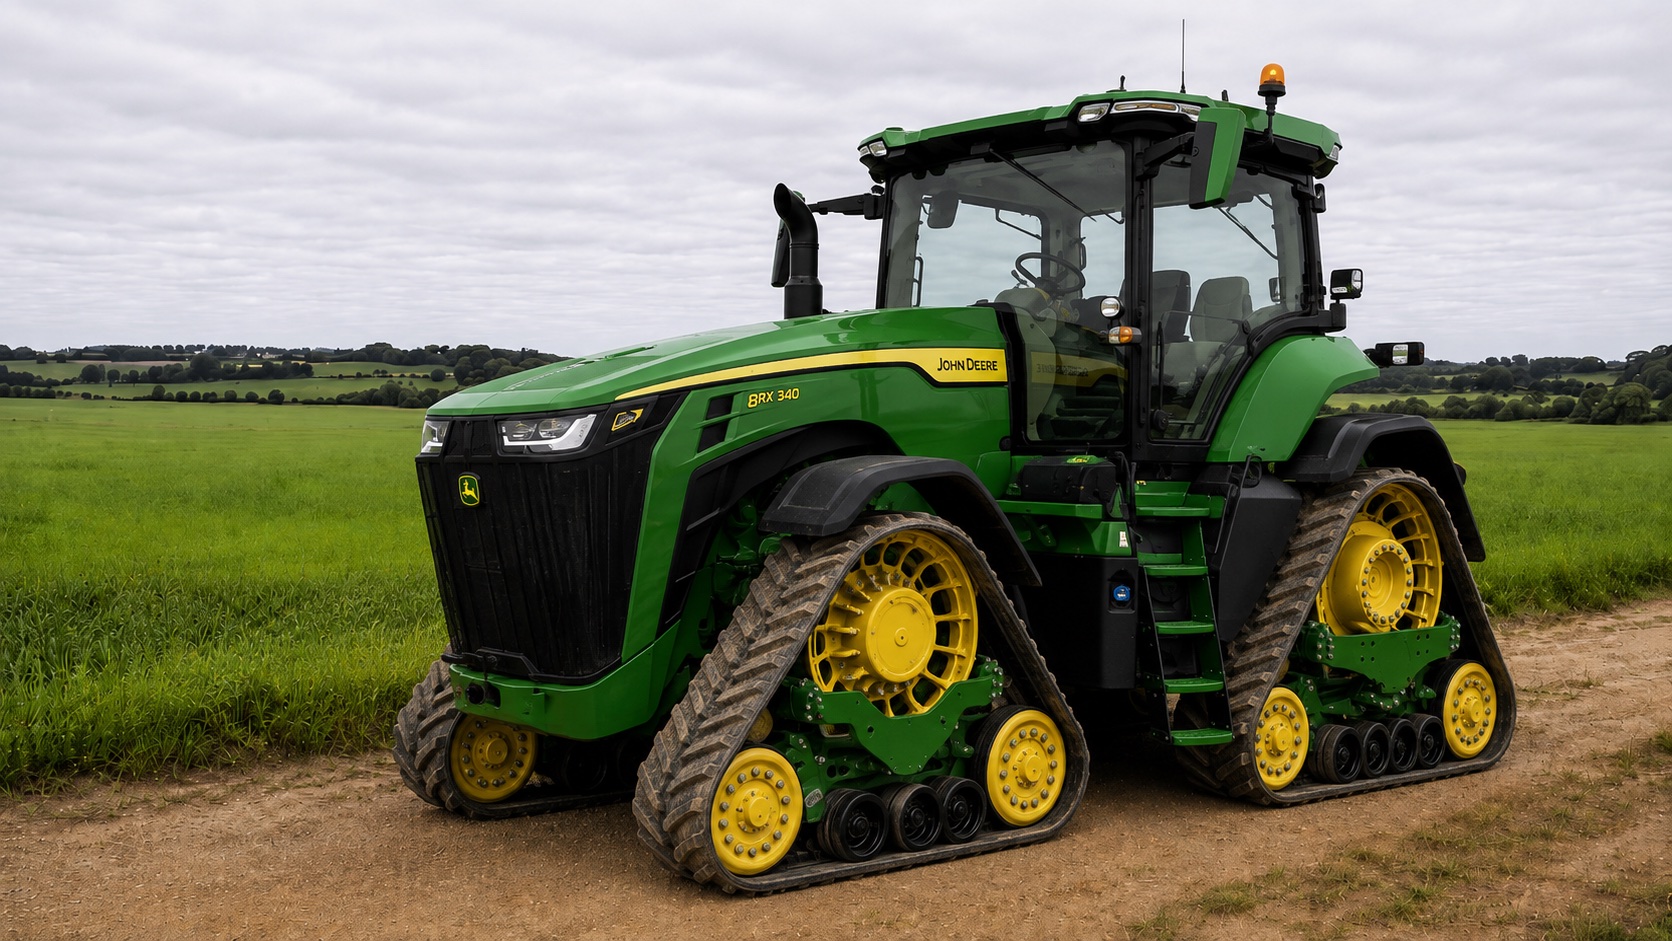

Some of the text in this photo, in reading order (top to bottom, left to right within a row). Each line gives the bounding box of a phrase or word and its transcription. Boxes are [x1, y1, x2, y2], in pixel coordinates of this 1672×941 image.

[937, 357, 998, 371] JOHN DEERE
[748, 388, 800, 408] 8RX 340
